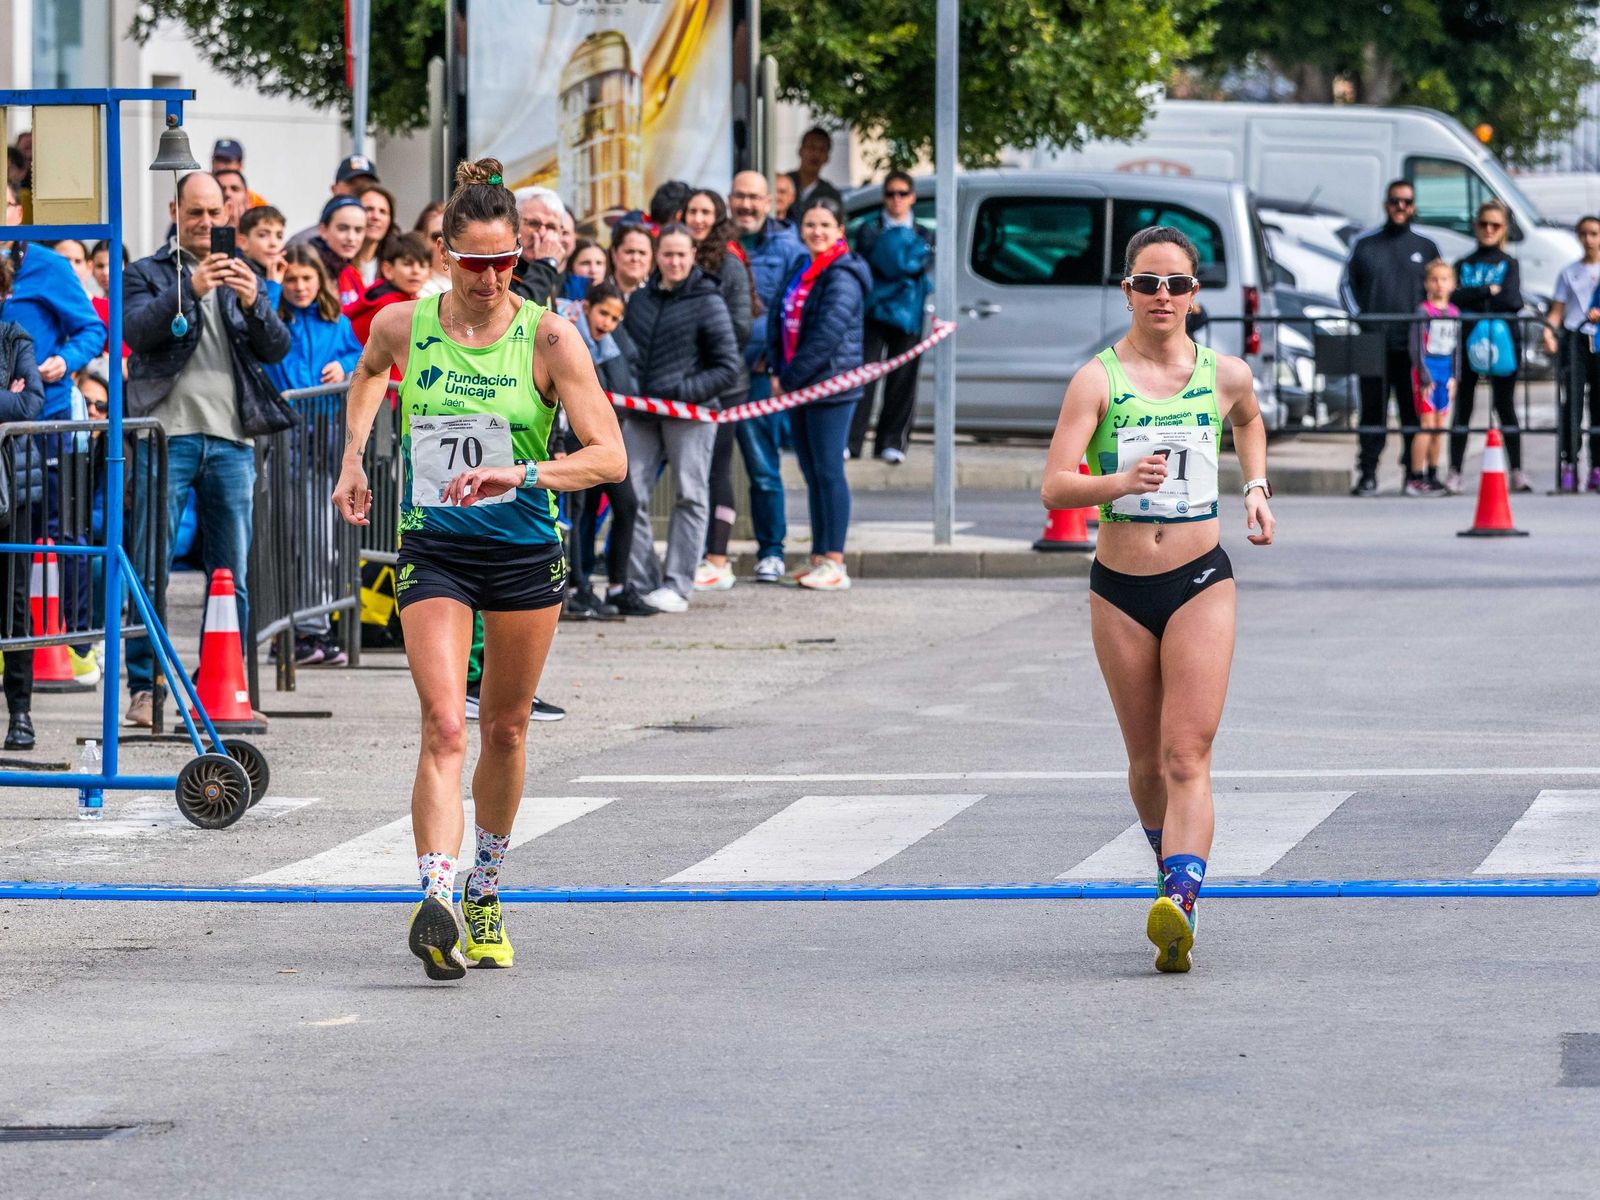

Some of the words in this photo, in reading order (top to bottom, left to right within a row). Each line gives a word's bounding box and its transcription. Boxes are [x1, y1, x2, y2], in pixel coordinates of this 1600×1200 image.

[446, 370, 518, 387] Fundación
[444, 382, 496, 400] Unicaja
[441, 397, 465, 408] Jaén
[1154, 411, 1192, 422] Fundación
[1154, 418, 1183, 427] Unicaja
[440, 436, 483, 470] 70
[1153, 448, 1189, 481] 71
